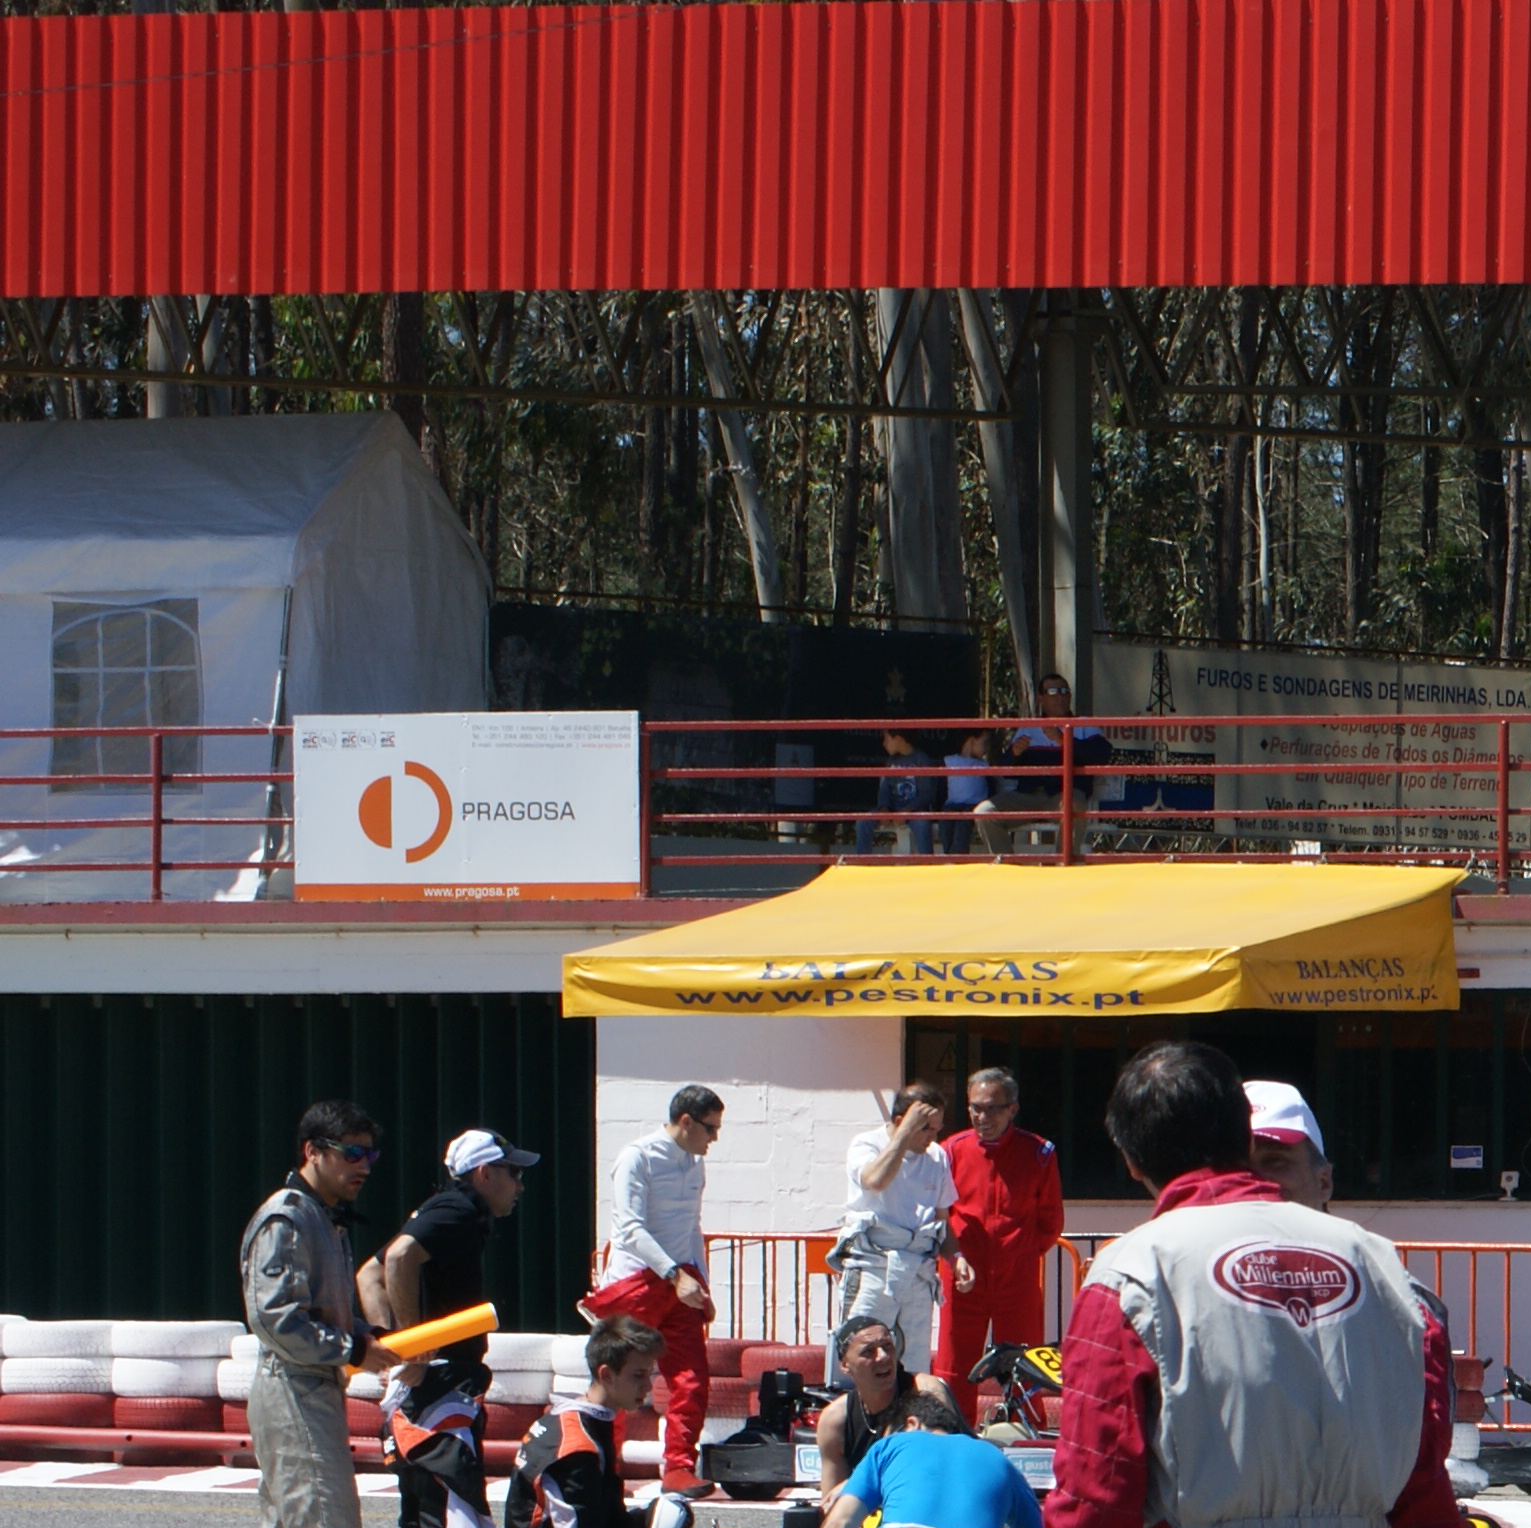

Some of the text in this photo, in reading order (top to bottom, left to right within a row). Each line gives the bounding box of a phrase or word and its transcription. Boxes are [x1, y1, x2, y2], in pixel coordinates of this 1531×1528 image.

[1196, 667, 1531, 709] FUROS E SONDAGENS DE MEIRINHAS, LDA.
[1411, 722, 1428, 738] de
[1270, 737, 1358, 759] Perfurações
[1362, 743, 1380, 757] de
[1385, 743, 1428, 763] Todos
[1432, 748, 1450, 764] os
[1430, 774, 1448, 790] de
[462, 801, 577, 822] PRAGOSA
[423, 885, 522, 900] www.pragosa.pt
[759, 960, 1060, 986] BALANÇAS
[1295, 957, 1406, 985] BALANÇAS
[674, 986, 1147, 1011] www.pestronix.pt
[1234, 1263, 1341, 1286] Millennium
